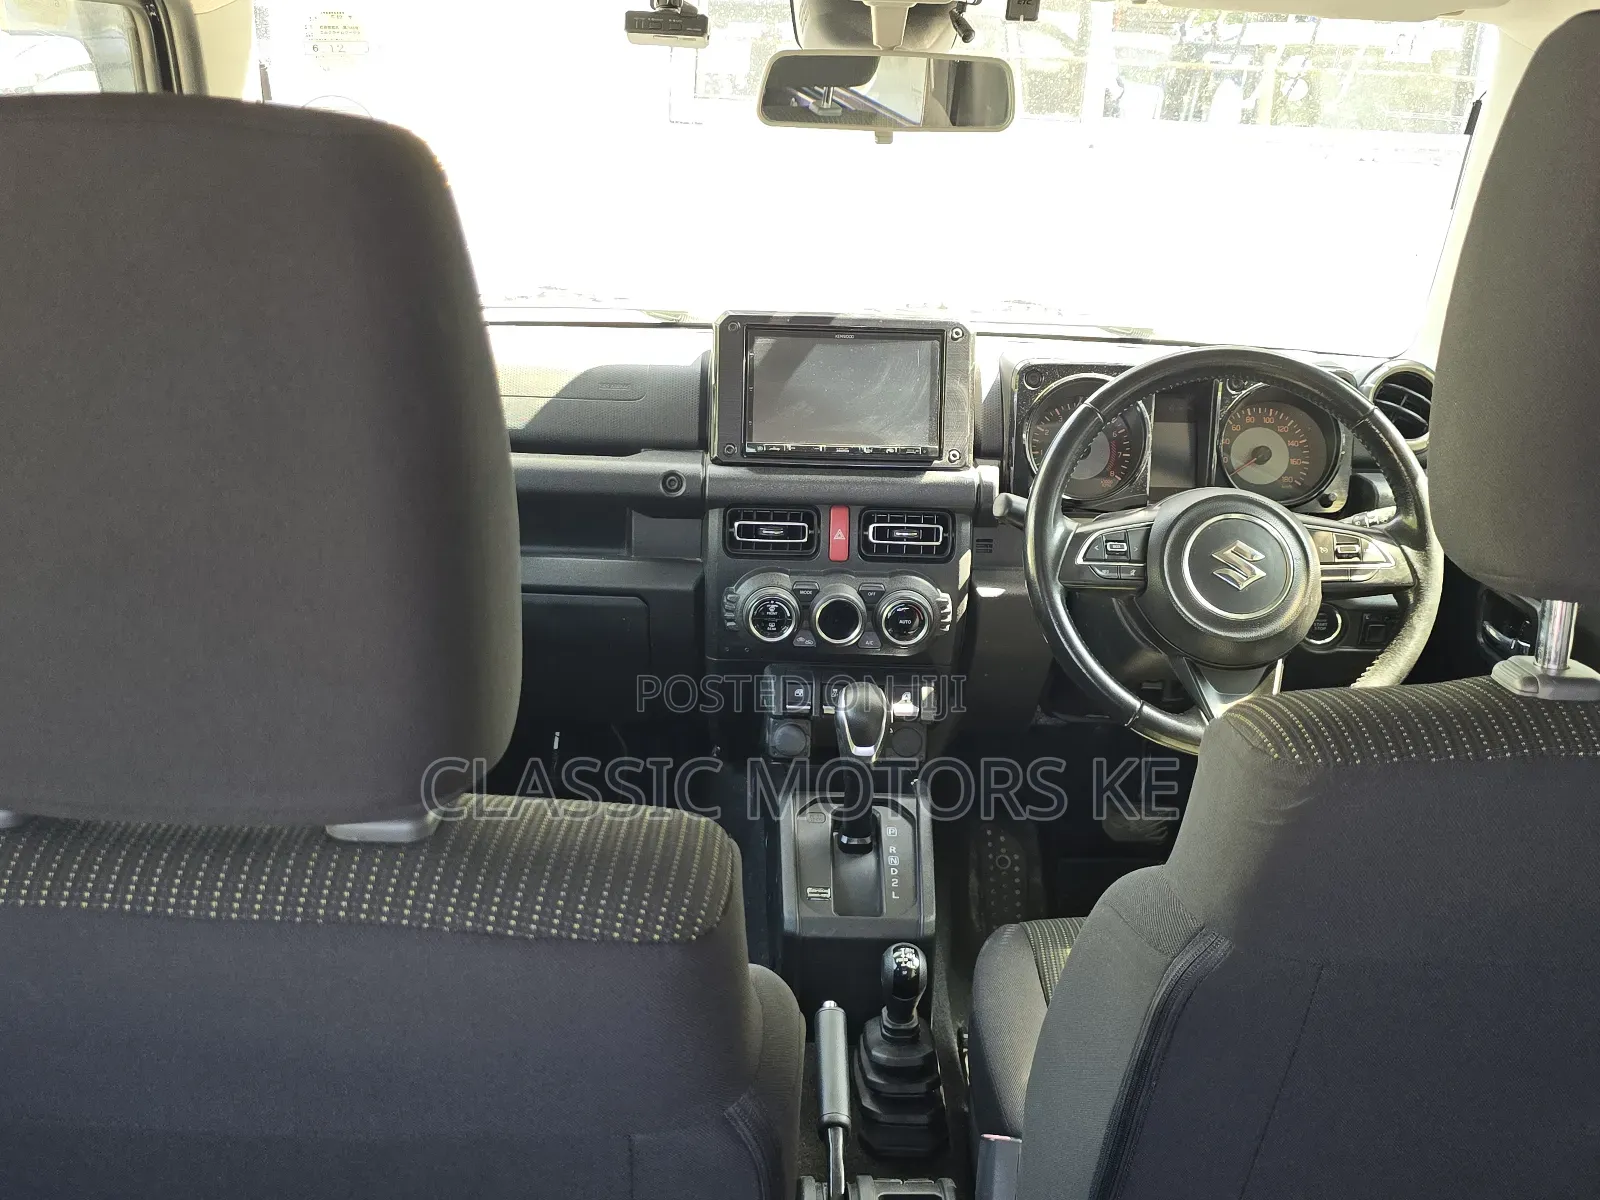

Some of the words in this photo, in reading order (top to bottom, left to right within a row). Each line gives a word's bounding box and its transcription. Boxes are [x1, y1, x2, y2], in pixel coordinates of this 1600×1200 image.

[312, 44, 319, 53] 6
[1245, 416, 1255, 424] 80
[1262, 416, 1275, 424] 100
[1231, 424, 1241, 432] 60
[1277, 425, 1289, 433] 120
[1287, 439, 1299, 447] 140
[888, 827, 896, 836] P
[889, 845, 897, 854] R
[890, 856, 898, 865] N
[890, 867, 898, 875] D
[891, 878, 899, 887] 2
[892, 891, 900, 899] L
